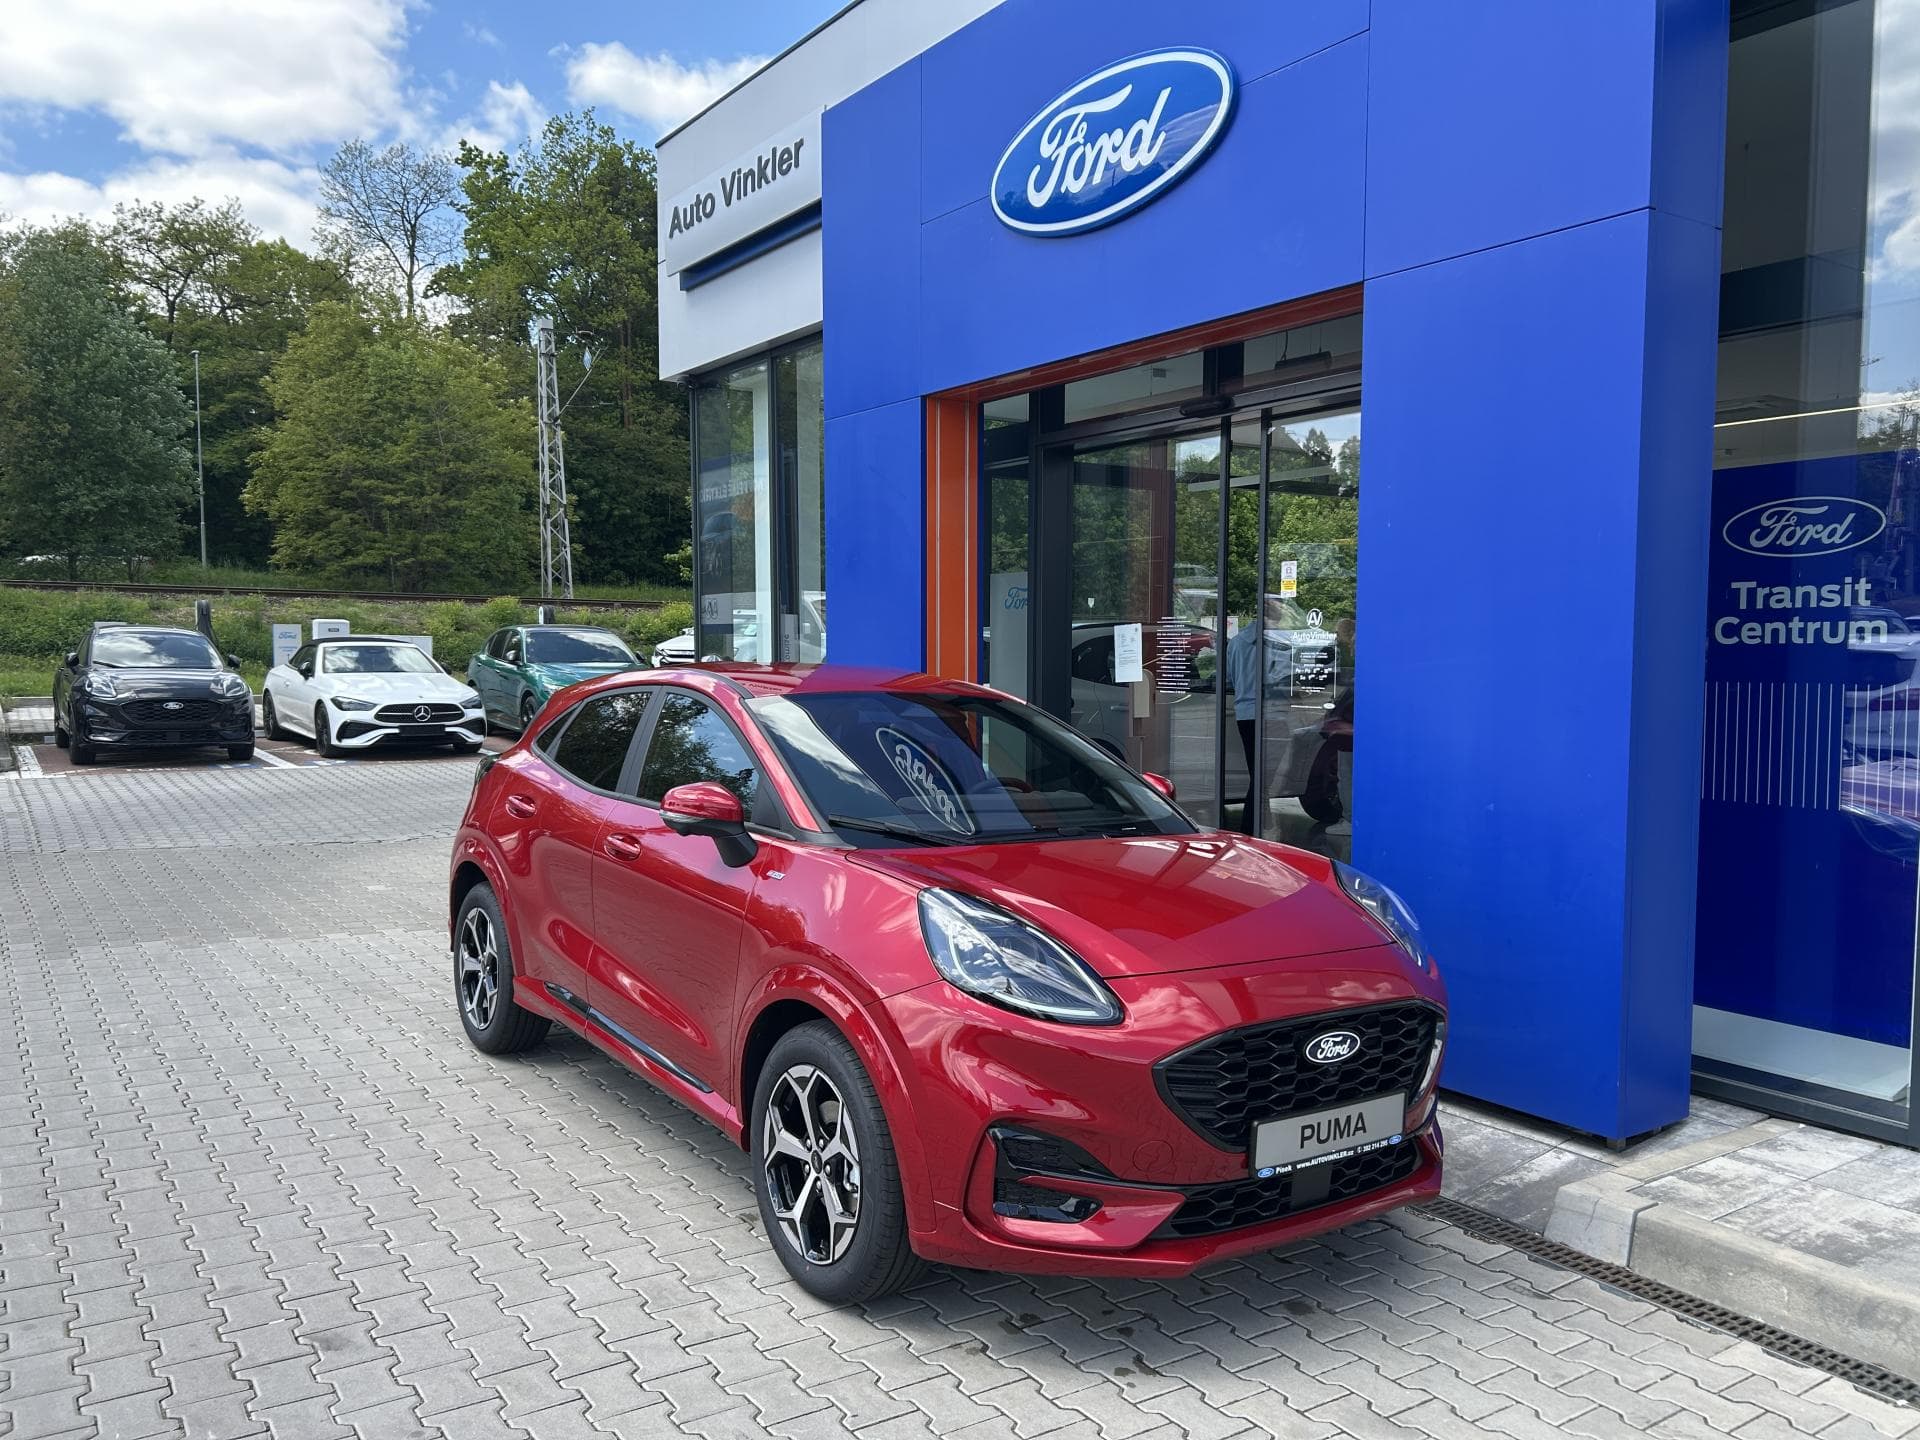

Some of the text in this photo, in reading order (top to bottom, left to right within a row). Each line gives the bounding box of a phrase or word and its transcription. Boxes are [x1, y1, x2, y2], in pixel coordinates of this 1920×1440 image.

[1027, 83, 1172, 208] Ford
[669, 137, 804, 240] Auto Vinkler
[1749, 505, 1856, 548] Ford
[1004, 586, 1028, 609] For
[1731, 576, 1871, 610] Transit
[1714, 616, 1888, 645] Centrum
[1316, 1035, 1351, 1059] Ford
[1300, 1111, 1367, 1150] PUMA
